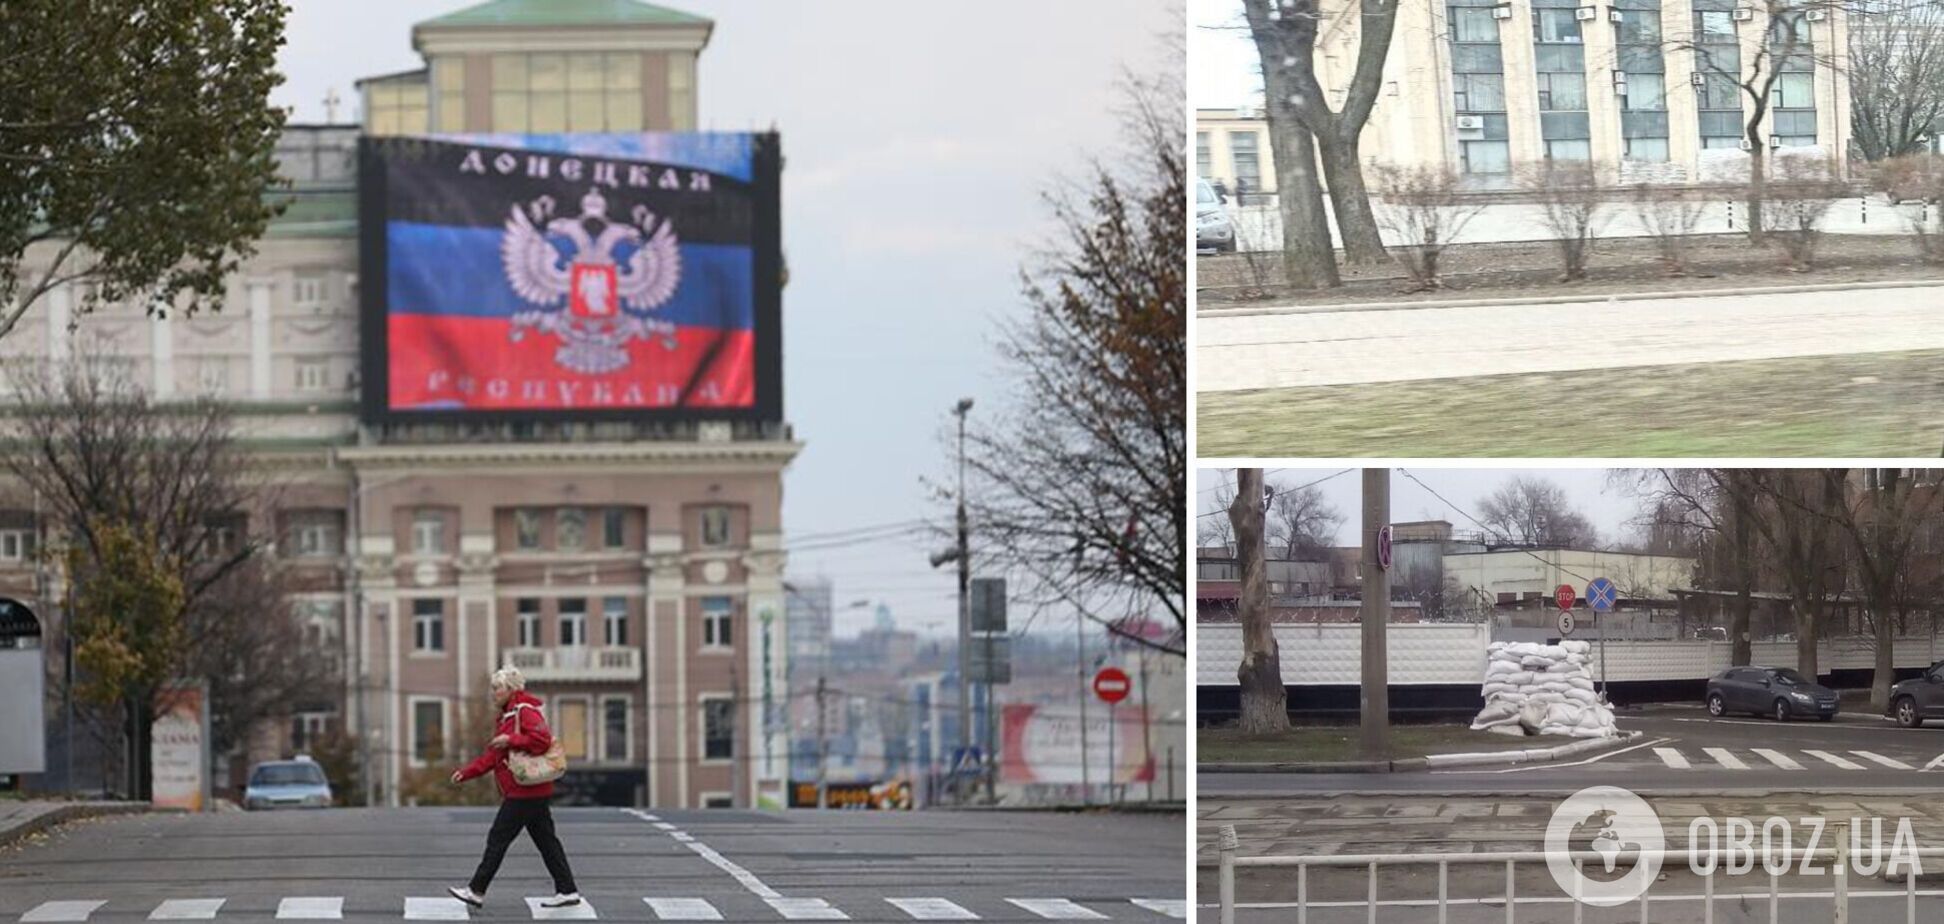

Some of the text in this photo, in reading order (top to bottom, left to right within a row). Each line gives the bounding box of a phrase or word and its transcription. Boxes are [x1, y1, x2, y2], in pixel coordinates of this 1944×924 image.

[427, 369, 721, 407] РЕСПУБЛИА
[1558, 592, 1574, 601] STOP
[1563, 617, 1569, 628] 5
